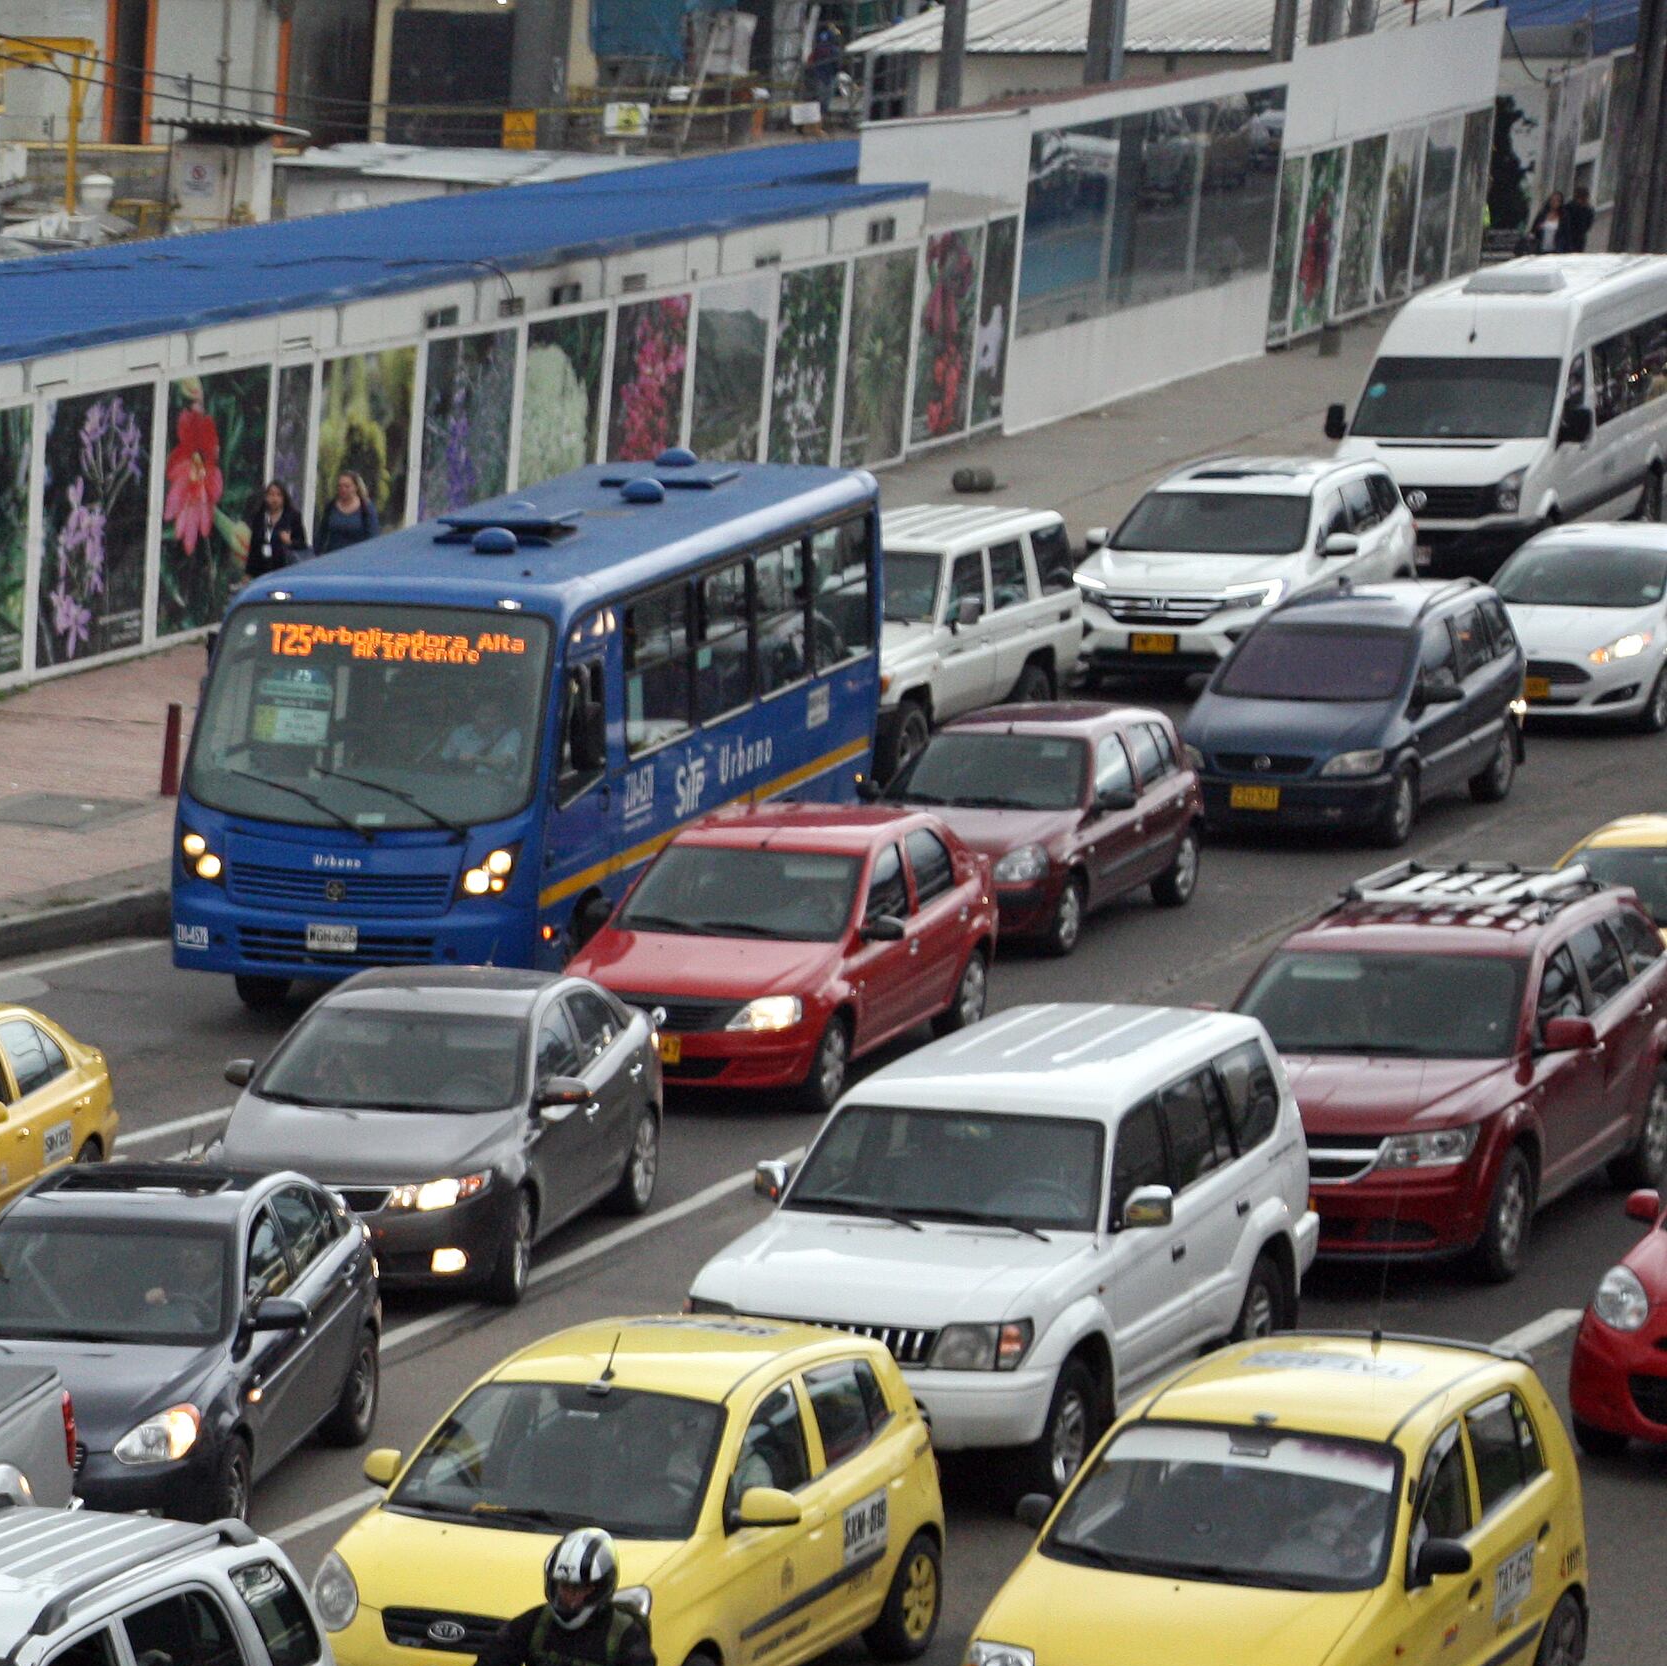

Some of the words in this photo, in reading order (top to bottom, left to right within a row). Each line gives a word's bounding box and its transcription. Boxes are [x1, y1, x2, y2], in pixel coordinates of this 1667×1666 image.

[270, 622, 313, 656] T25
[311, 626, 469, 650] Arbolizadora
[478, 633, 526, 655] Alta
[719, 735, 773, 785] Urbano
[313, 854, 362, 868] Urbano
